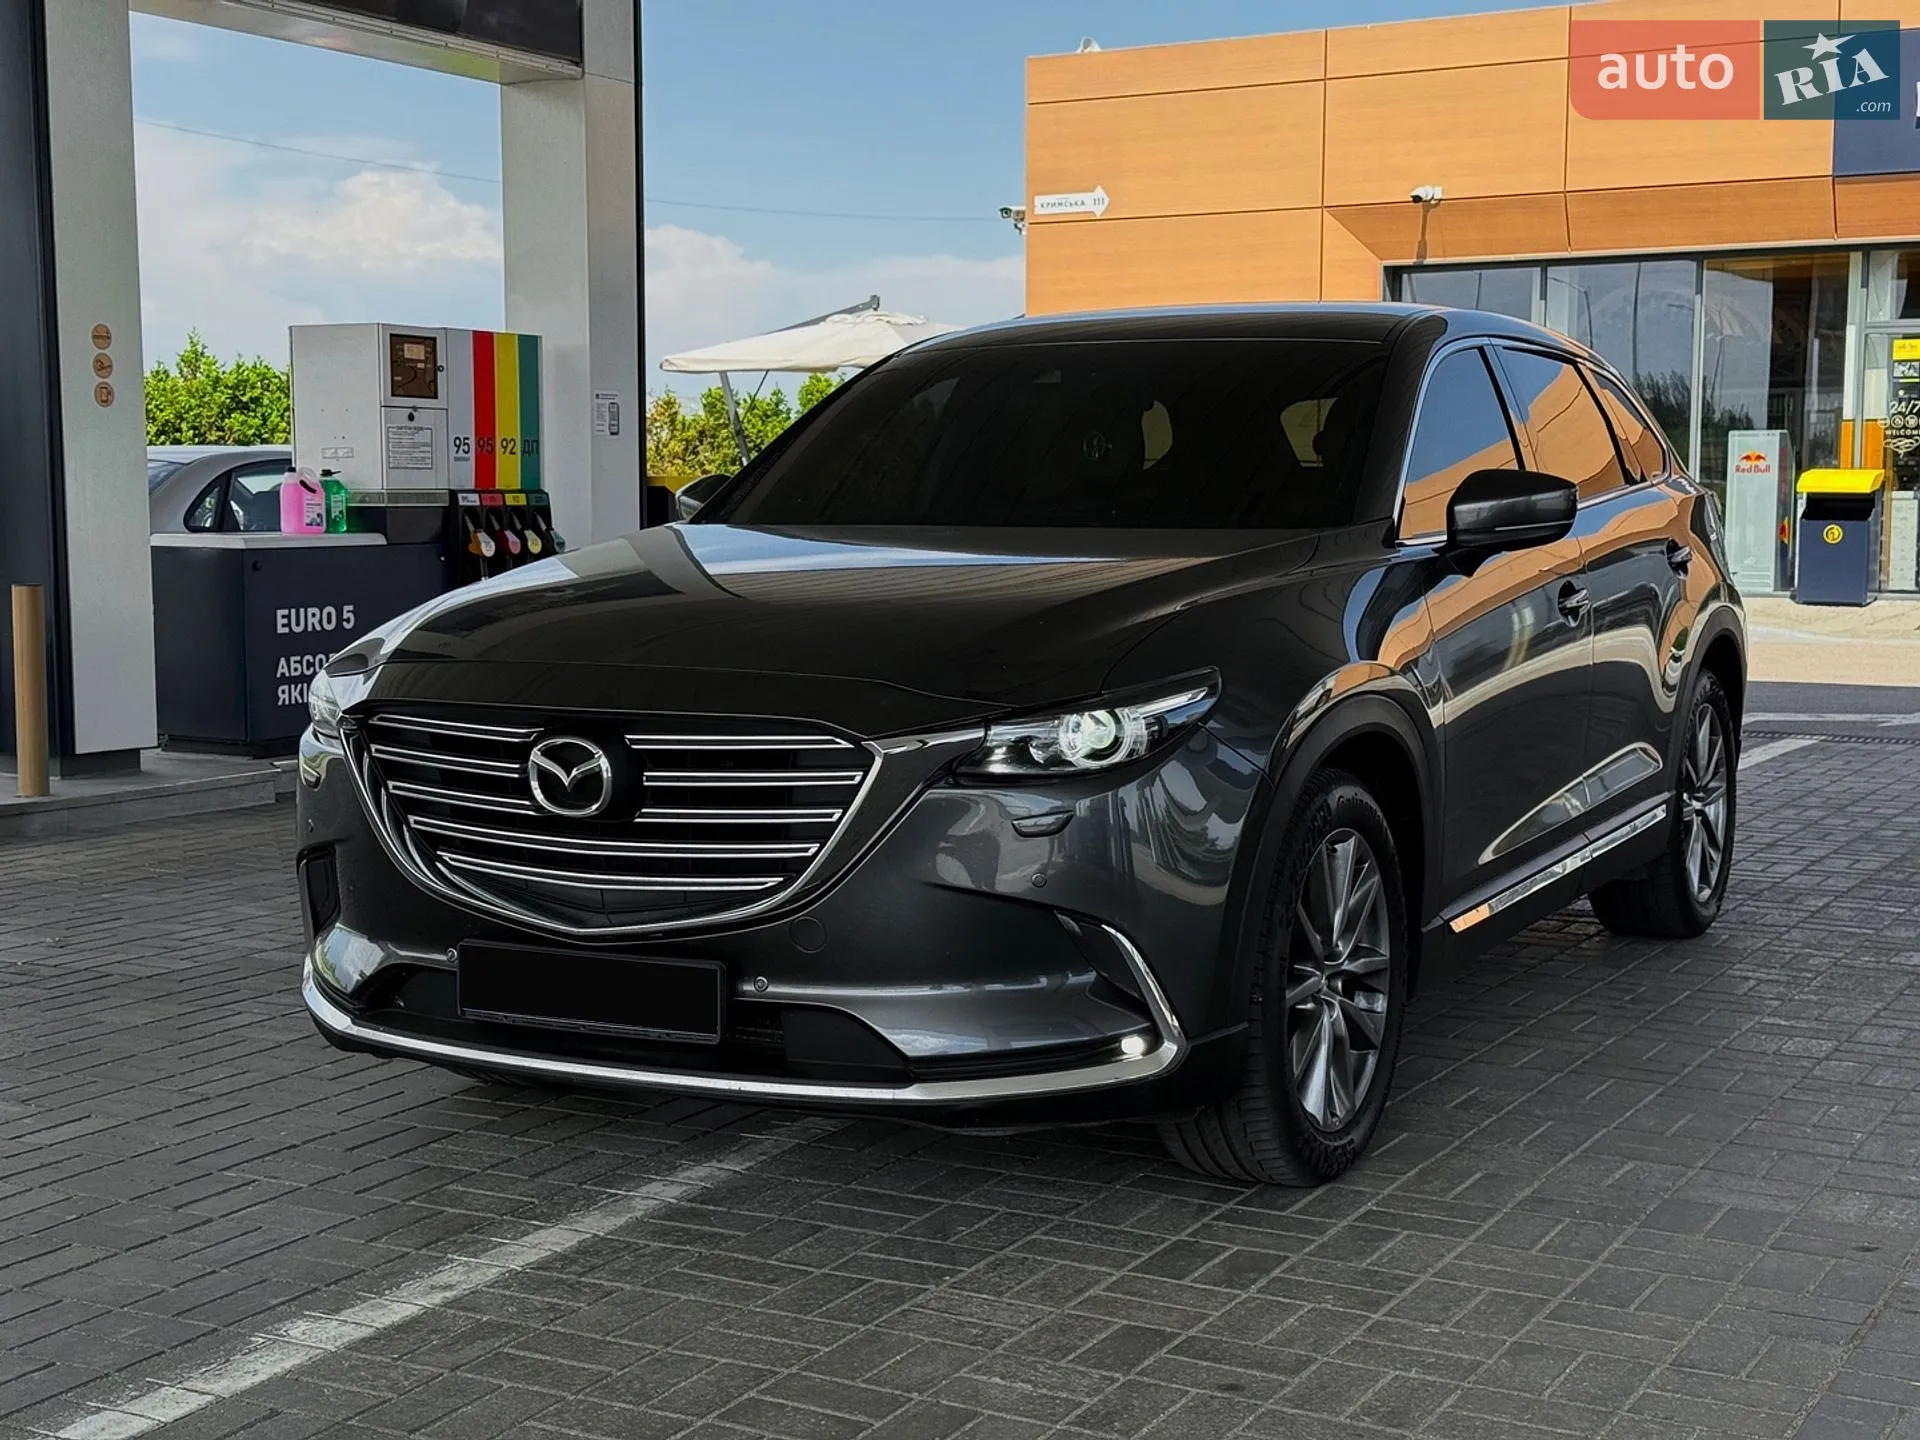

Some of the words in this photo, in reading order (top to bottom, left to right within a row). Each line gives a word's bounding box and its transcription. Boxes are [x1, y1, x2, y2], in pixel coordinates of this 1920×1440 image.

[1890, 400, 1920, 415] 24/7
[453, 436, 471, 455] 95
[477, 437, 495, 455] 95
[501, 438, 517, 456] 92
[522, 439, 539, 456] ДП
[1735, 464, 1753, 473] Red
[1754, 464, 1771, 473] Bull
[276, 606, 337, 634] EURO
[342, 605, 355, 630] 5
[276, 653, 336, 678] АБСО
